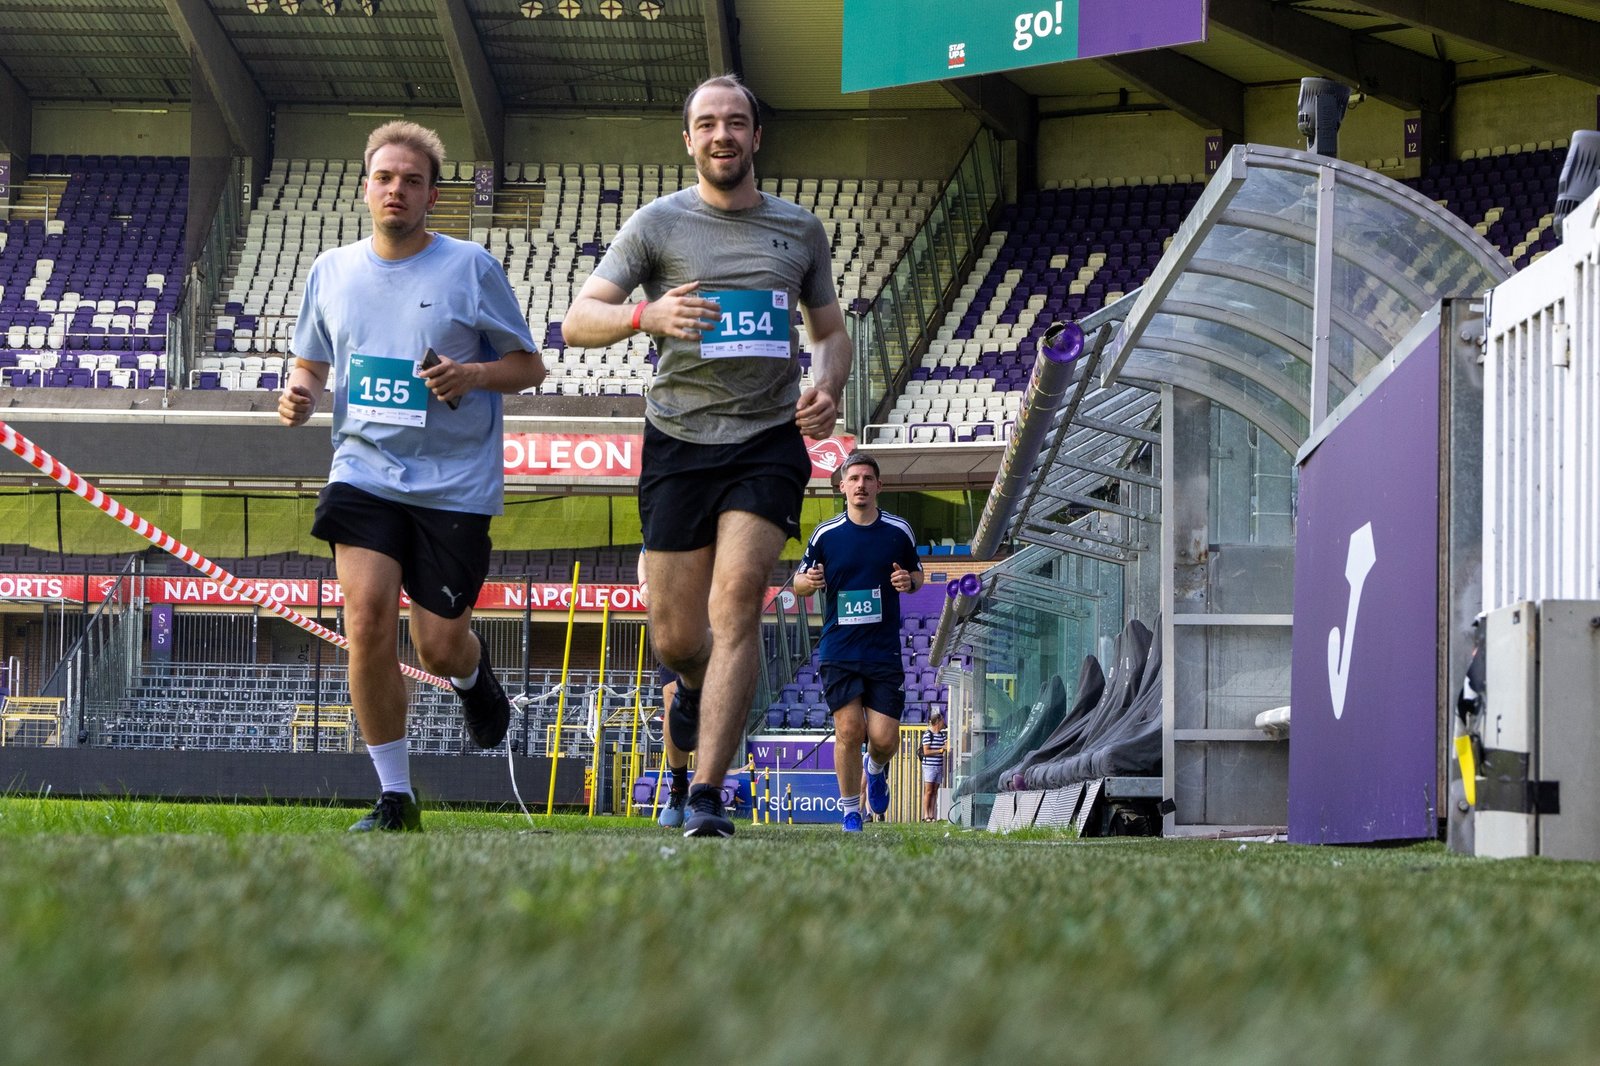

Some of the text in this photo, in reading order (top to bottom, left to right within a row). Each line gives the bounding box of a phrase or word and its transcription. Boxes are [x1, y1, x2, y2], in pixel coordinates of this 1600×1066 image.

[1013, 1, 1063, 51] go!
[1407, 124, 1417, 134] W
[1208, 141, 1219, 151] W
[1408, 142, 1417, 153] 12
[1210, 160, 1217, 170] 11
[480, 173, 488, 183] S
[720, 311, 774, 336] 154
[359, 376, 410, 404] 155
[503, 439, 632, 469] OLEON
[0, 577, 62, 597] ORTS
[844, 600, 873, 615] 148
[158, 613, 166, 623] S
[157, 633, 165, 644] 5
[757, 746, 770, 758] W
